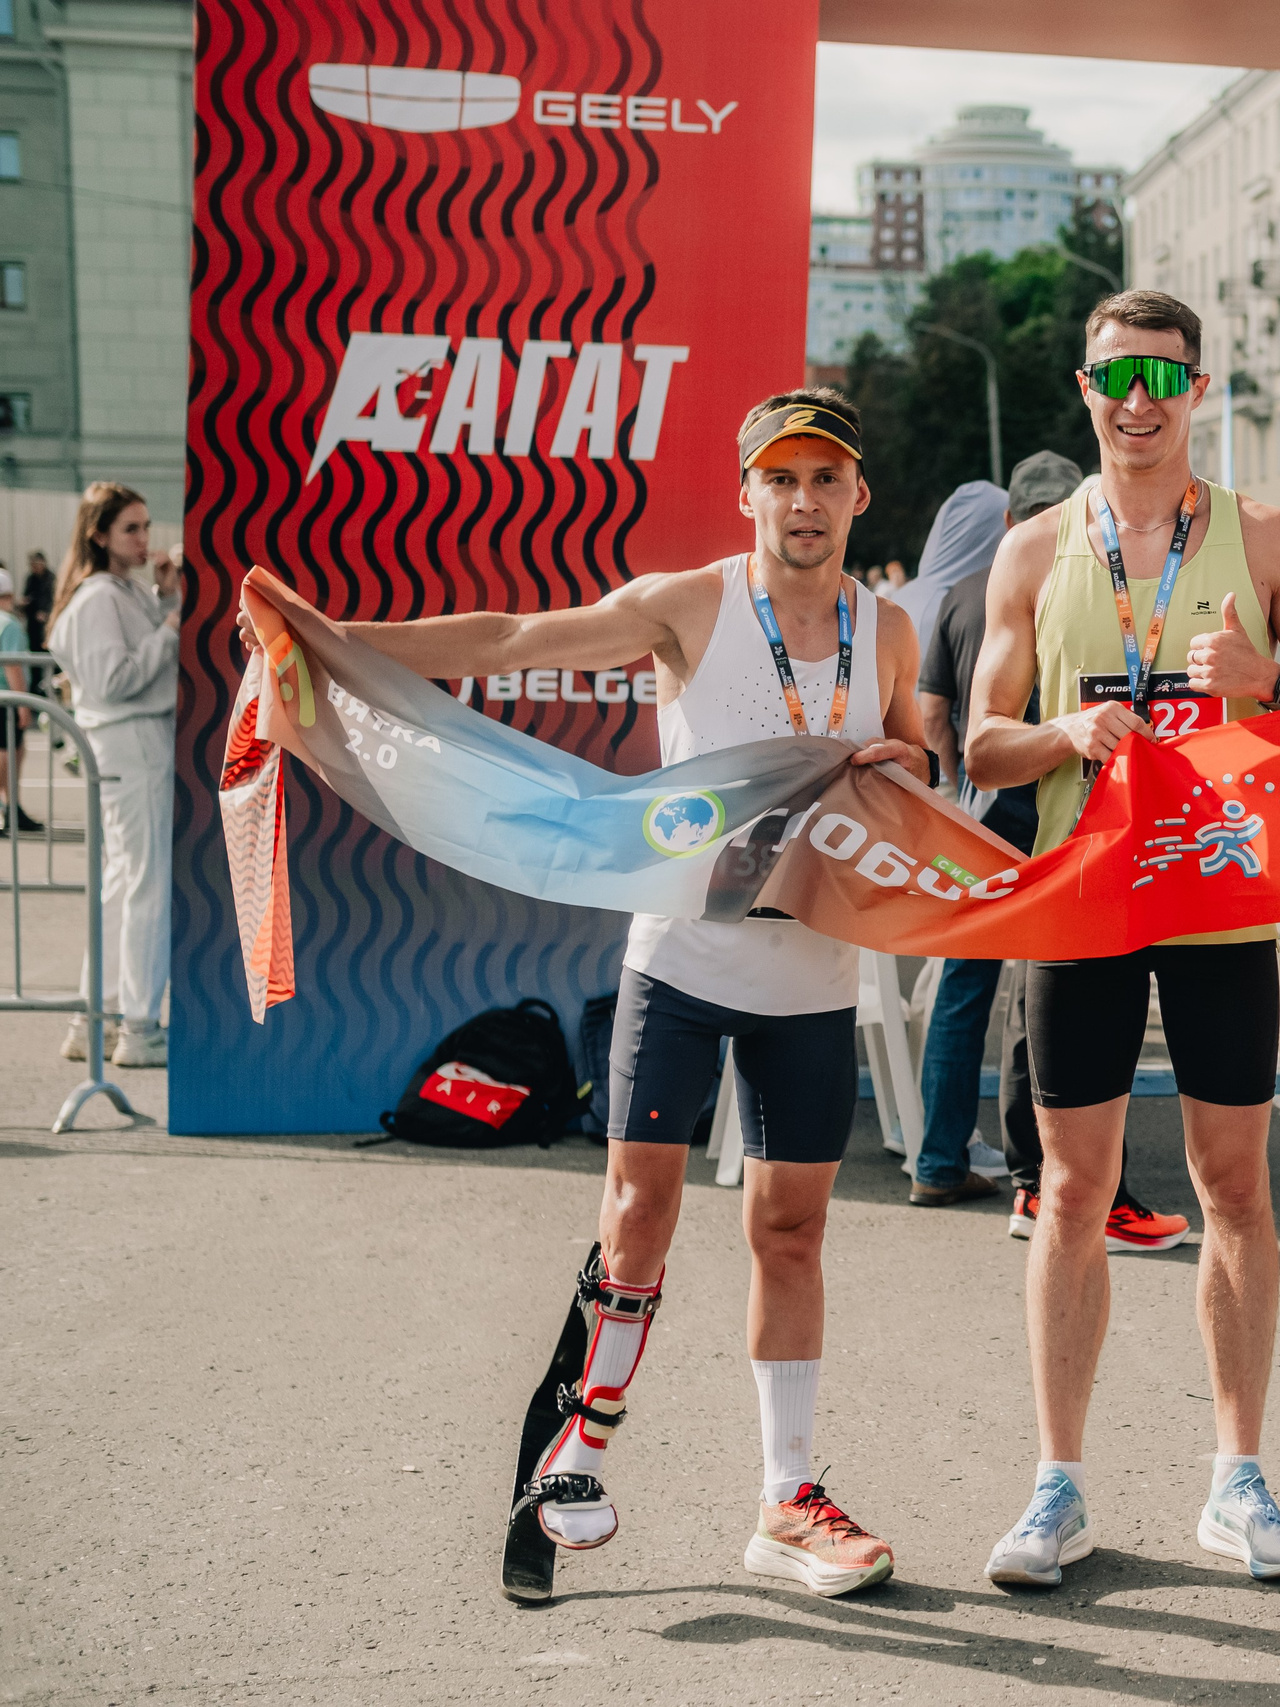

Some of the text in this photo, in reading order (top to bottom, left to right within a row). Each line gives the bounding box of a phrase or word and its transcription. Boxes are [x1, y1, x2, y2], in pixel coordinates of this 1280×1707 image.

[533, 90, 738, 134] GEELY
[1165, 557, 1176, 583] ГЛОБУС
[1154, 598, 1165, 618] 2025
[1126, 632, 1136, 653] 2025
[487, 668, 656, 703] BELGE
[1105, 685, 1132, 693] ГЛОБ
[327, 679, 441, 753] ВЯТКА
[345, 728, 398, 770] 2.0
[937, 860, 975, 886] СИС
[436, 1079, 501, 1115] AIR
